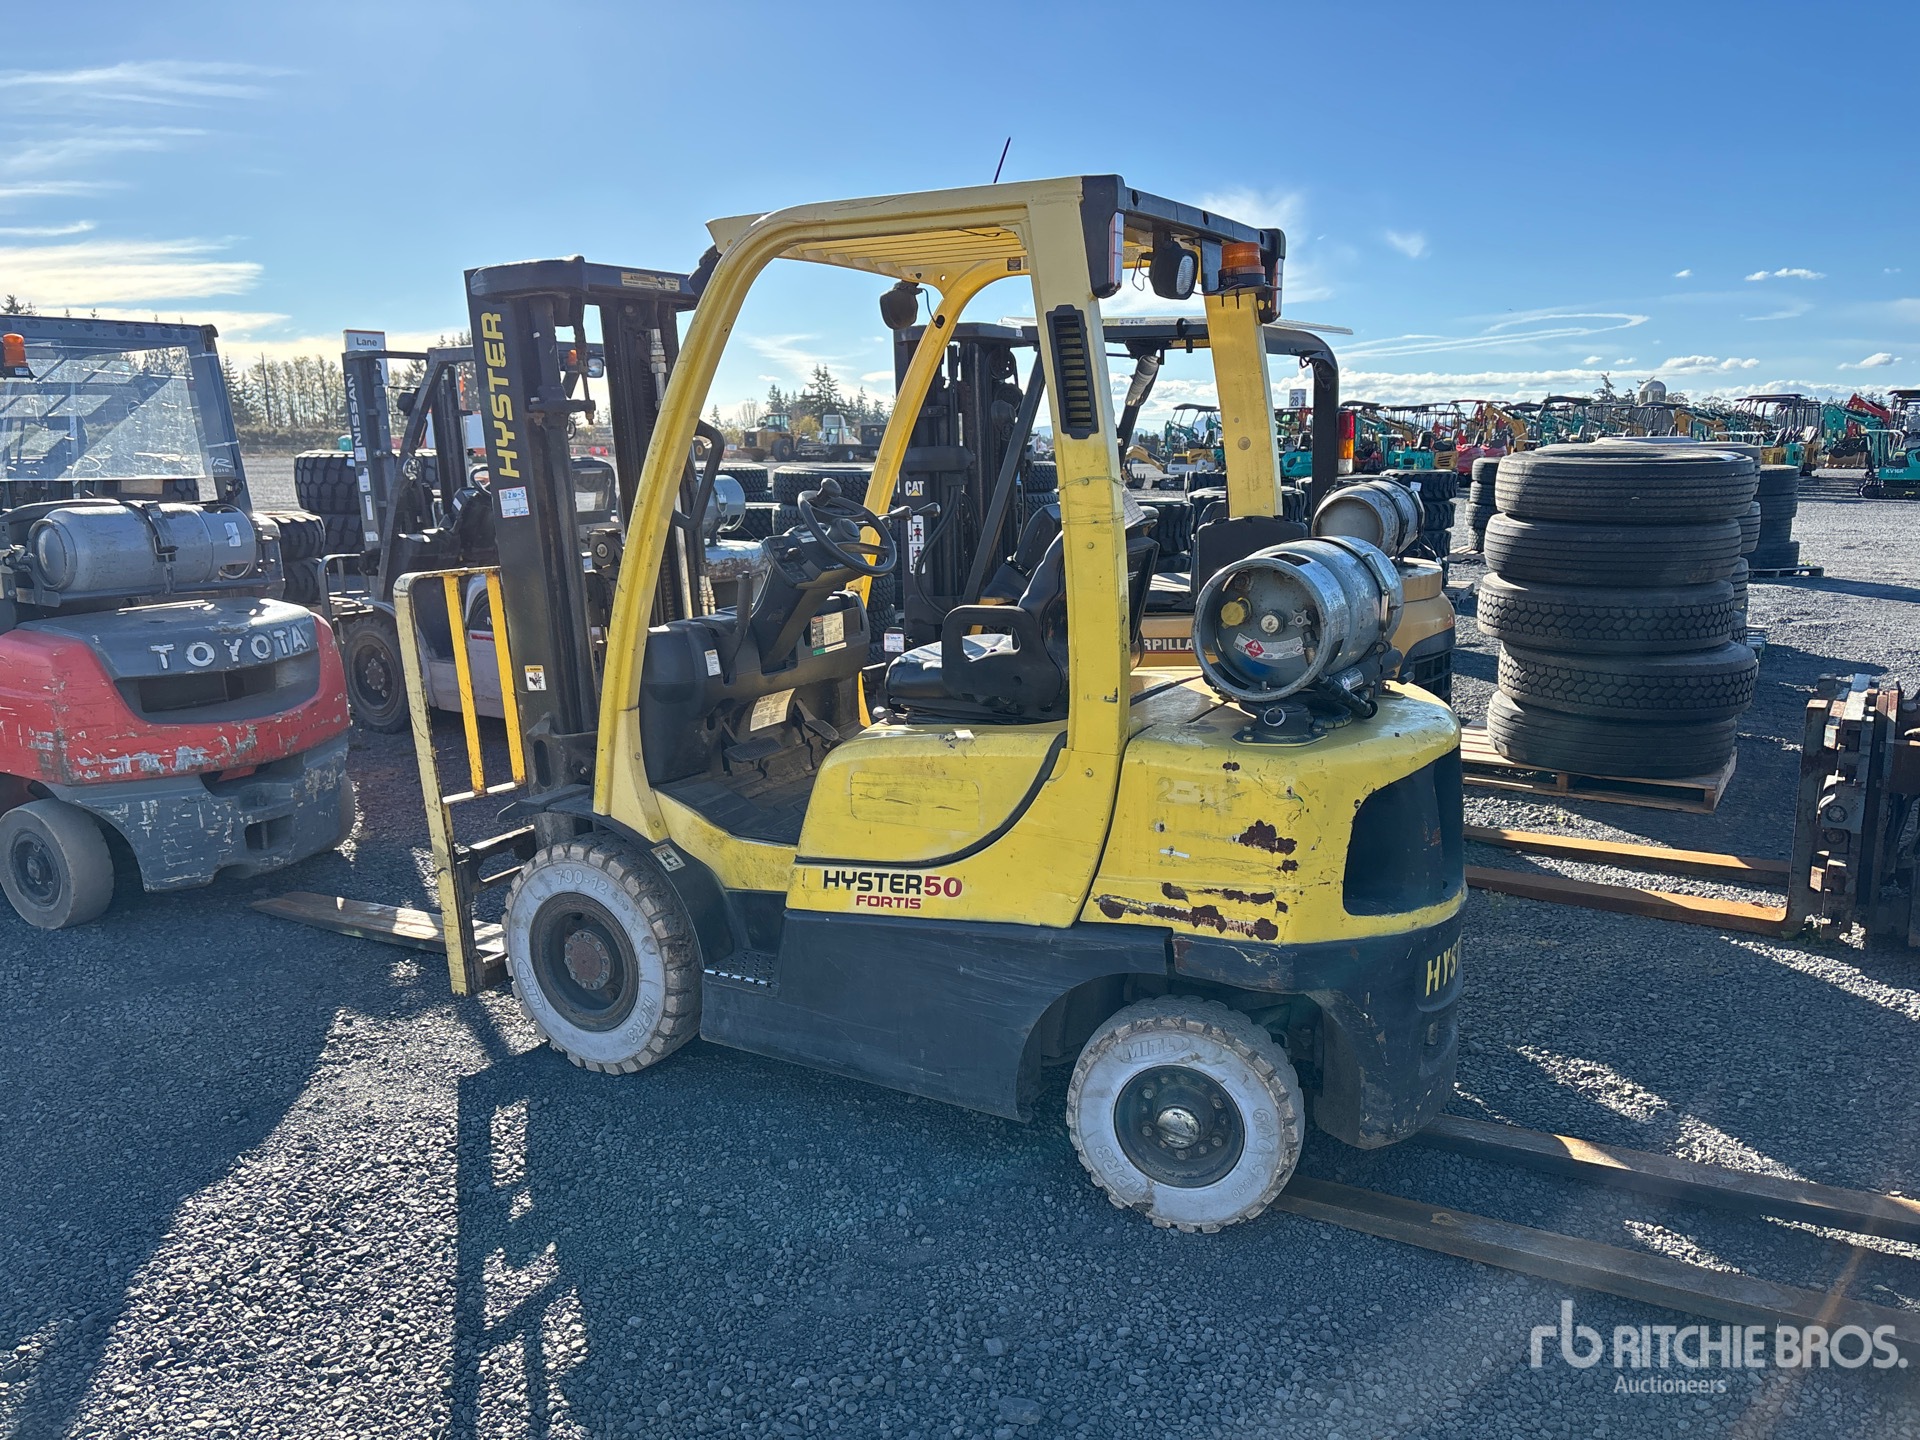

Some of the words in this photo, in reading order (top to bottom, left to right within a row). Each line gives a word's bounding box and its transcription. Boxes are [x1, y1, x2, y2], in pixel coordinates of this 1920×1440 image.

[356, 337, 378, 347] Lane
[481, 312, 520, 478] HYSTER
[346, 373, 363, 446] NISSAN
[905, 480, 924, 496] CAT
[150, 624, 310, 669] TOYOTA
[1143, 638, 1194, 650] RPILLA
[555, 869, 609, 896] 700-12
[823, 870, 922, 894] HYSTER
[924, 875, 963, 898] 50
[855, 895, 921, 909] FORTIS
